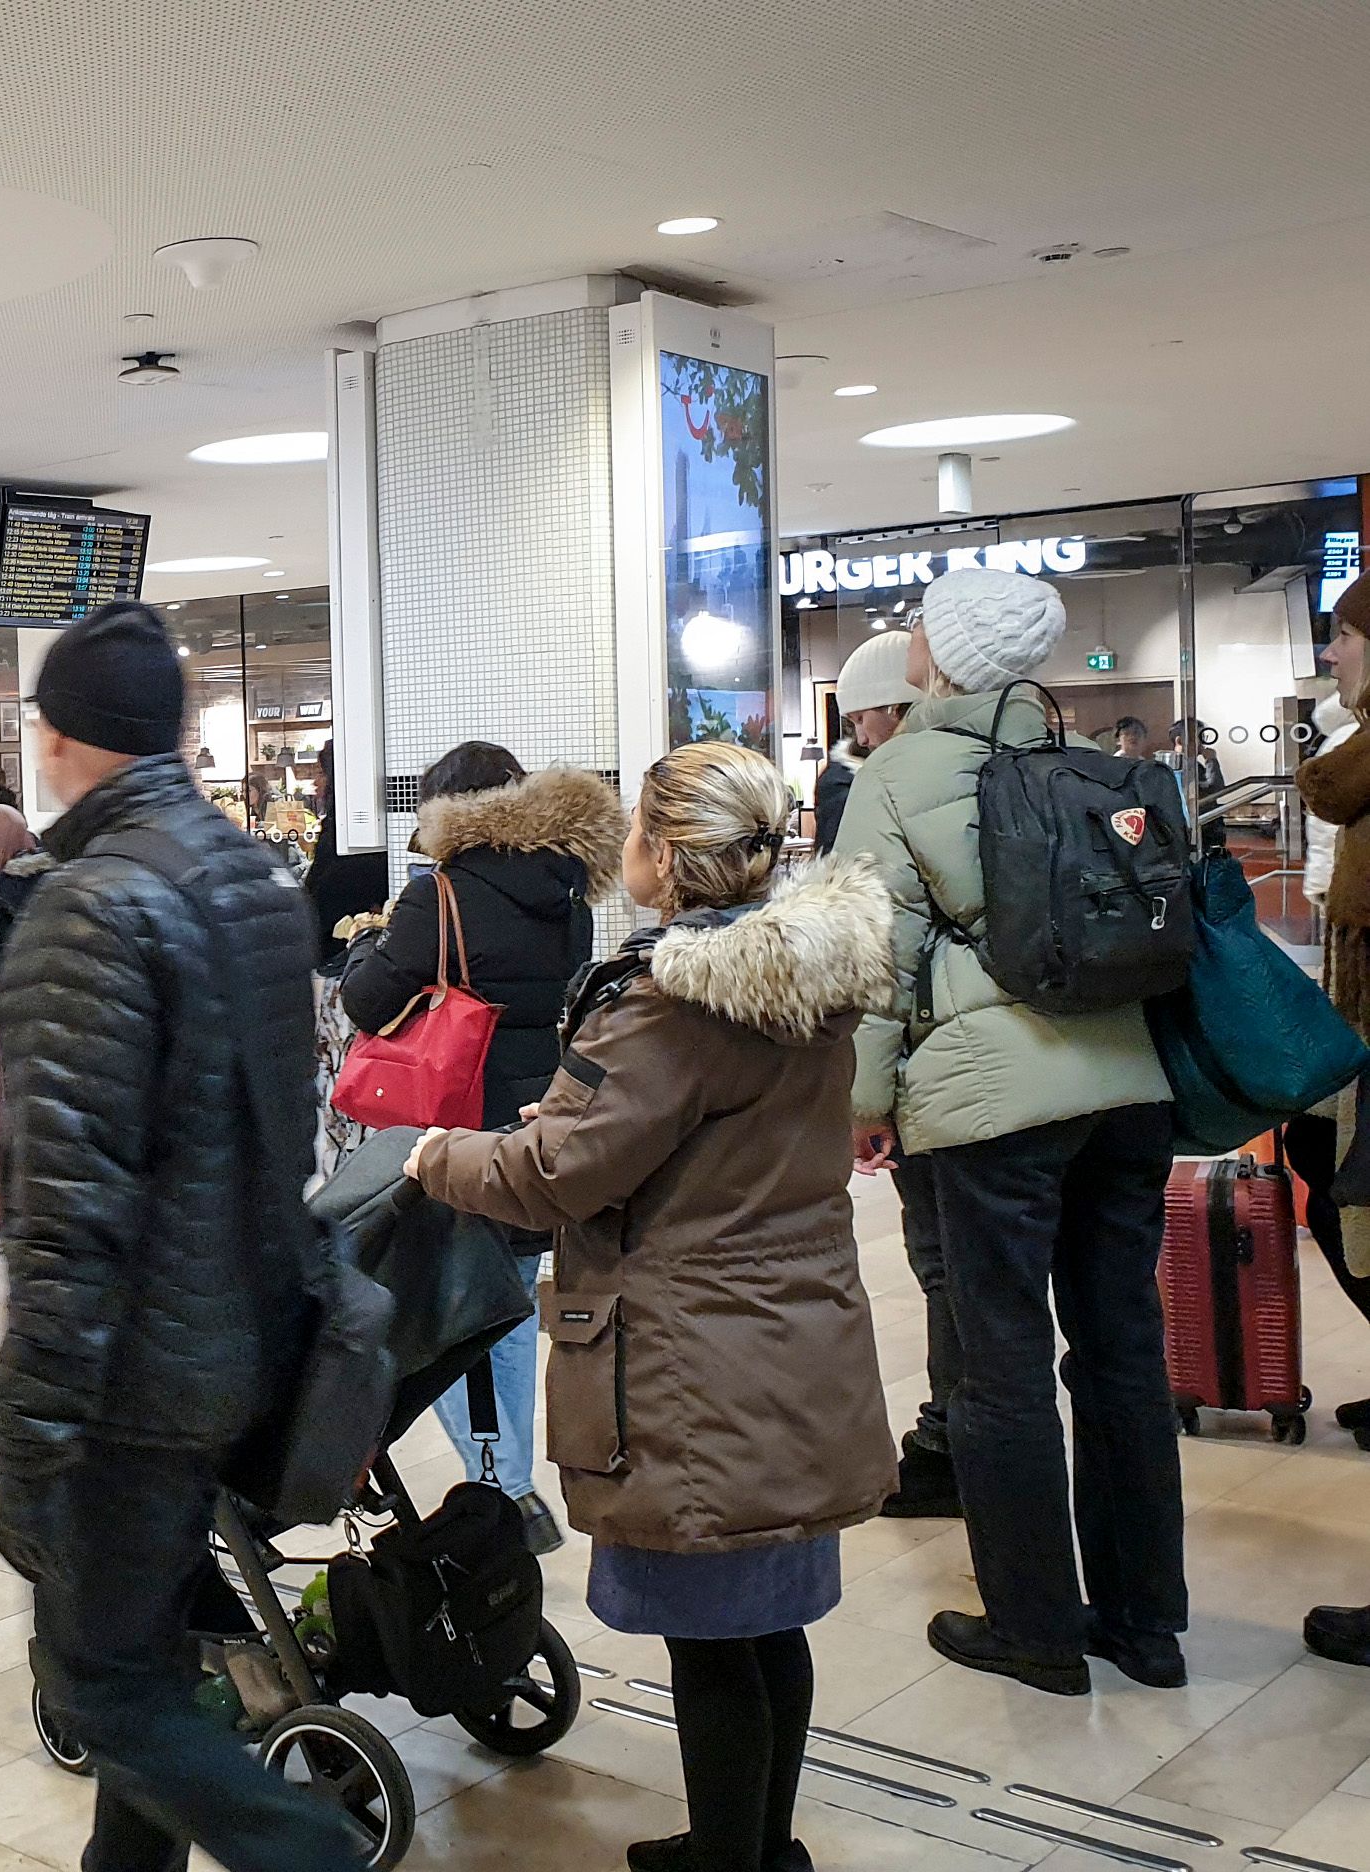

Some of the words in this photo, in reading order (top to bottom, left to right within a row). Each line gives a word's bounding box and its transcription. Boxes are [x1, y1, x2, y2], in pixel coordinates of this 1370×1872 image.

[779, 550, 934, 596] URGER
[944, 534, 1087, 575] KING
[257, 706, 281, 718] YOUR
[299, 704, 322, 716] WAY
